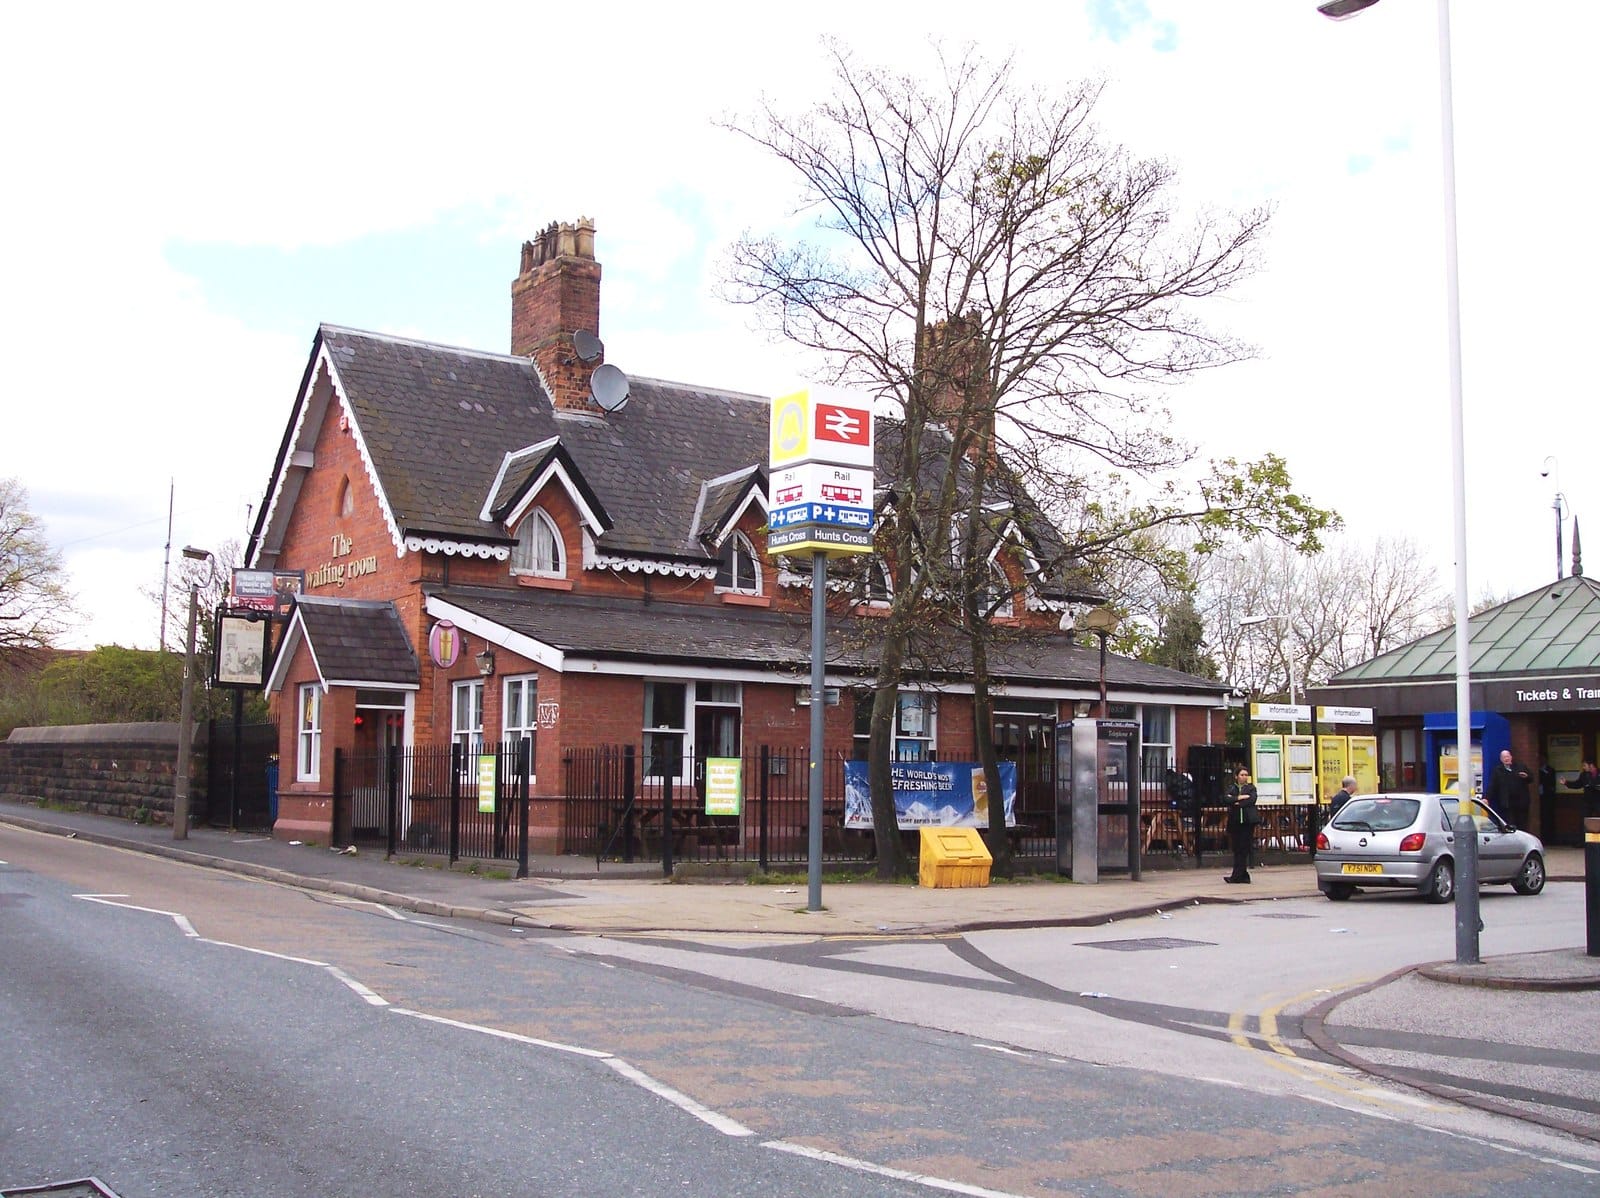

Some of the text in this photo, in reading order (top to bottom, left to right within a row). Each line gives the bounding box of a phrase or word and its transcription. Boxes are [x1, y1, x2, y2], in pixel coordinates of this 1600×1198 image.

[834, 471, 850, 481] Rail
[771, 531, 806, 545] Hunts Cross
[814, 529, 868, 544] Hunts Cross
[331, 533, 353, 559] The
[305, 555, 377, 588] waiting room
[1516, 689, 1558, 701] Tickets
[1562, 688, 1571, 699] &
[1268, 706, 1299, 714] Information
[1334, 709, 1361, 717] Information
[891, 767, 904, 778] HE
[906, 769, 937, 780] WORLD'S
[892, 779, 937, 791] EFRESHING
